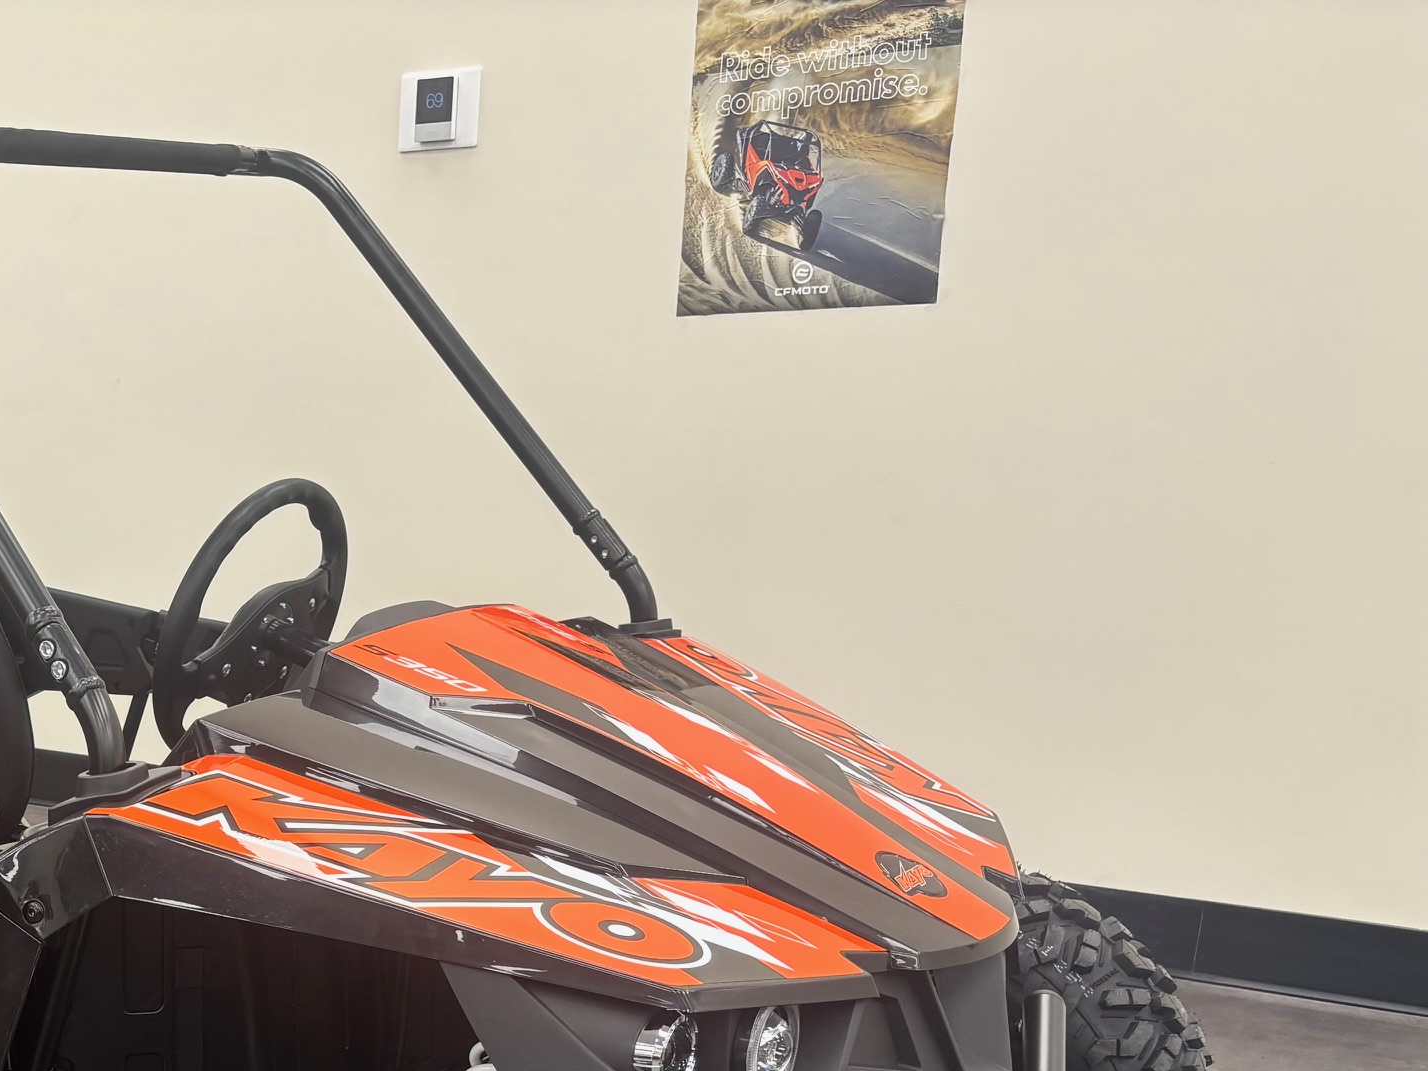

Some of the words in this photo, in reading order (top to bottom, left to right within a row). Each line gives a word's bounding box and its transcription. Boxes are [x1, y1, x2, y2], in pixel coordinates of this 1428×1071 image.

[719, 46, 791, 83] Ride
[797, 31, 932, 74] without
[425, 92, 444, 109] 69
[715, 67, 928, 120] compromise.
[774, 285, 829, 297] CFMOTO
[137, 770, 712, 969] KAYO
